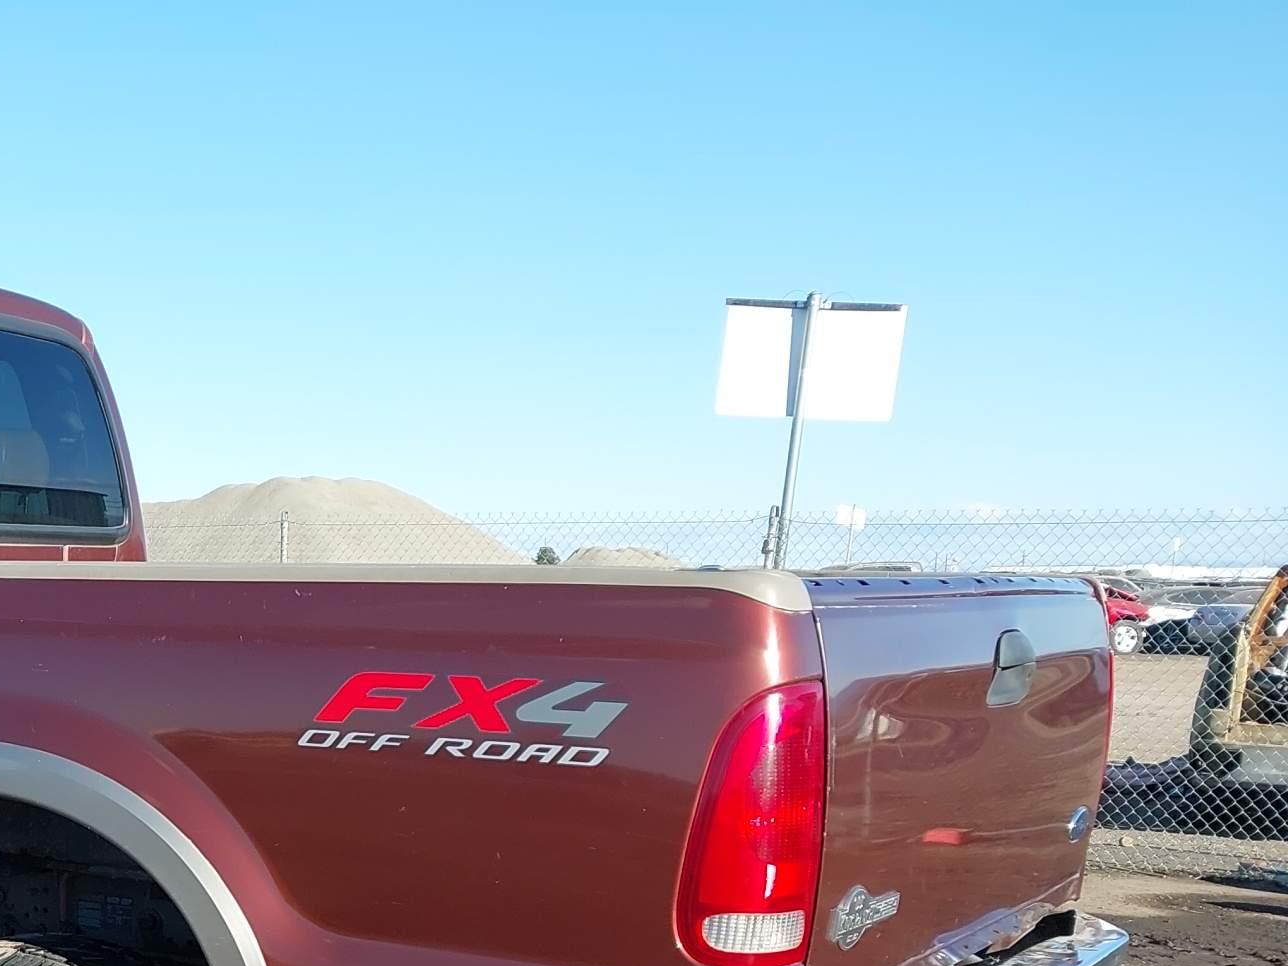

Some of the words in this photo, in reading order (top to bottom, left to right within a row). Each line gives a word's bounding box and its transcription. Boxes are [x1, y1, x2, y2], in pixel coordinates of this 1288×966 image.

[313, 671, 630, 739] FX4
[297, 729, 411, 752] OFF
[424, 737, 611, 768] ROAD
